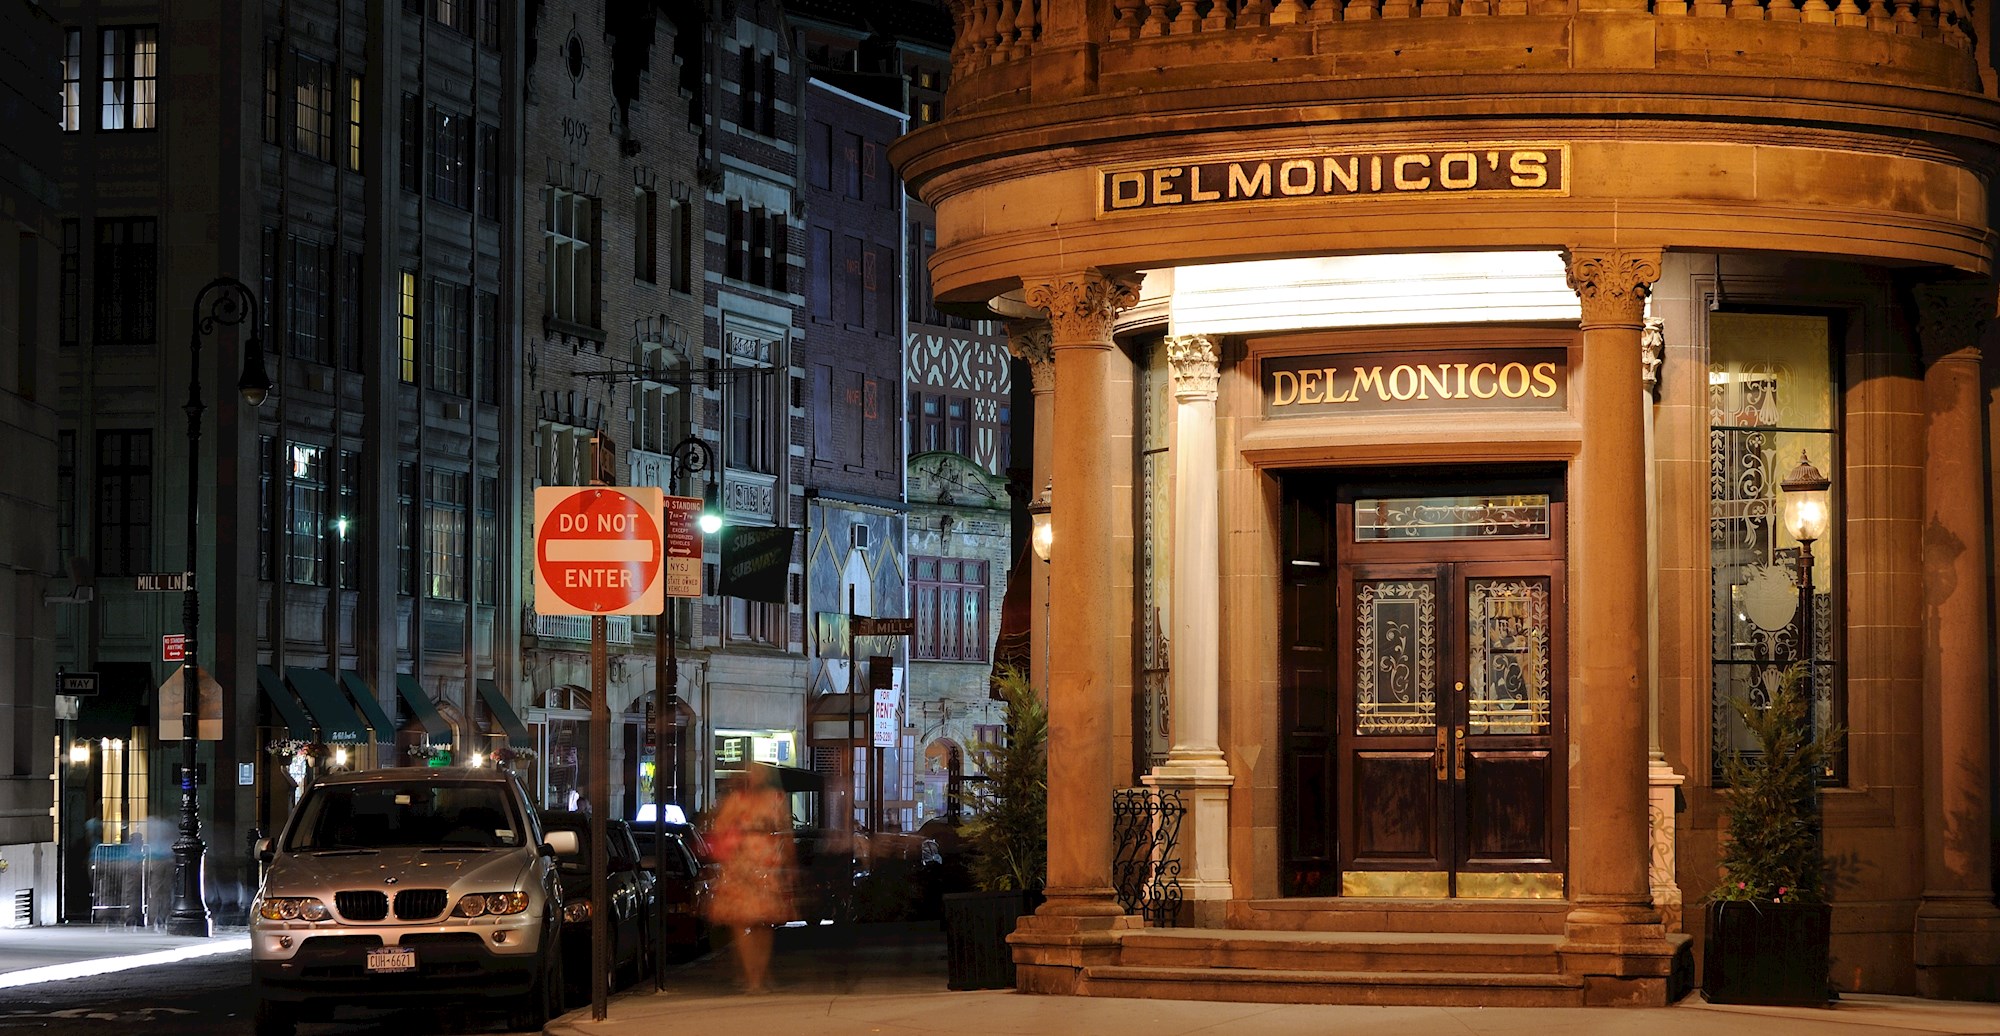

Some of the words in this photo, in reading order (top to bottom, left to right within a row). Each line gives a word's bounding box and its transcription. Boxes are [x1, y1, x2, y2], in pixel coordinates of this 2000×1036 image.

[1110, 150, 1549, 210] DELMONICO'S
[1272, 362, 1558, 406] DELMONICOS
[672, 500, 701, 511] STANDING
[559, 513, 588, 532] DO
[597, 513, 638, 532] NOT
[667, 533, 694, 541] AUTHORIZED
[137, 575, 161, 590] MILL
[167, 575, 182, 590] LN
[565, 569, 633, 588] ENTER
[667, 577, 681, 586] STATE
[681, 578, 698, 586] OWNED
[667, 585, 690, 593] VEHICLES
[876, 622, 906, 633] MILL
[69, 679, 90, 688] WAY
[880, 691, 890, 700] FOR
[875, 702, 894, 719] RENT
